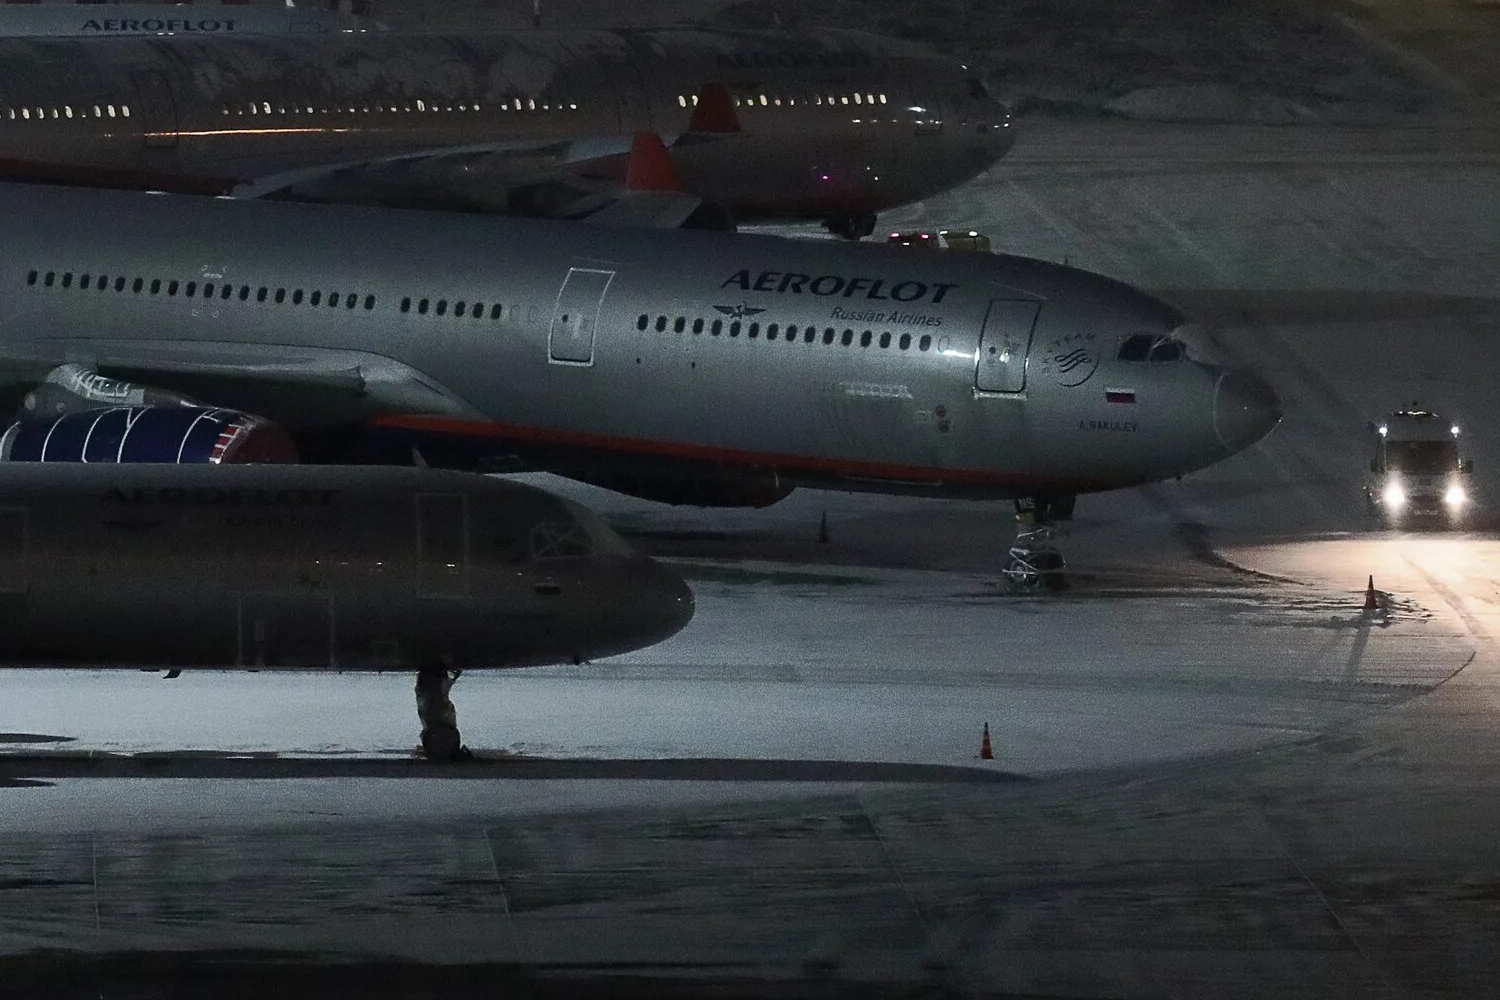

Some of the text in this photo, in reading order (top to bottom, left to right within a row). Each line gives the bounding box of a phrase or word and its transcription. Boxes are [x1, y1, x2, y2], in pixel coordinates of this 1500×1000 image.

[80, 18, 237, 32] AEROFLOT
[720, 268, 960, 304] AEROFLOT
[831, 305, 943, 327] Russian Airlines
[100, 488, 341, 506] AEROFLOT
